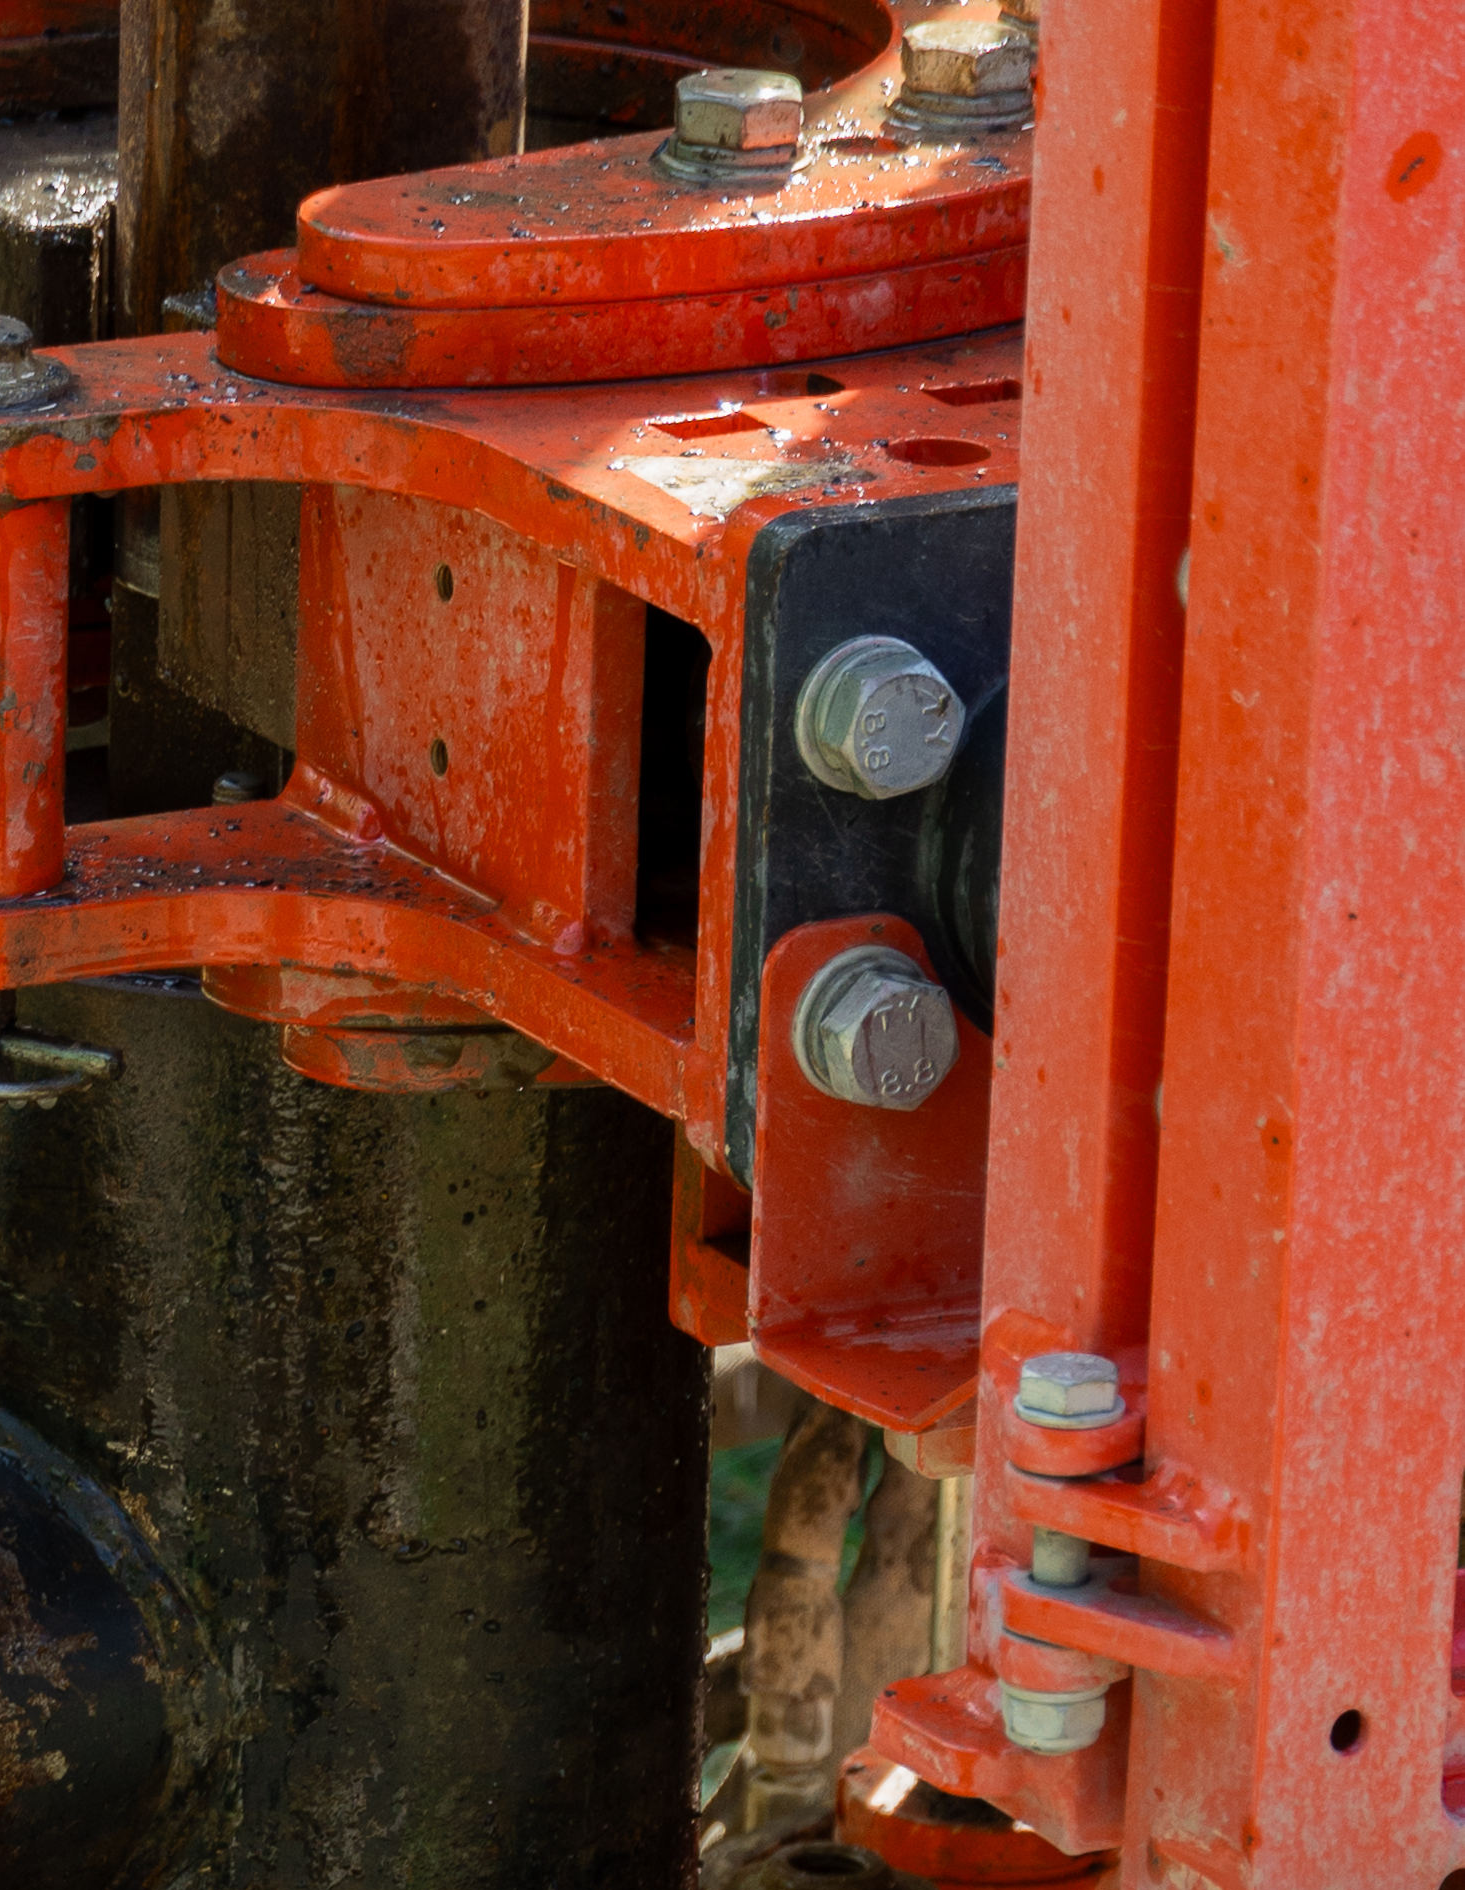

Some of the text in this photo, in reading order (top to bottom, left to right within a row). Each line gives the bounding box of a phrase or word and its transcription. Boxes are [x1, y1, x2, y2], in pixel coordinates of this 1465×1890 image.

[861, 709, 892, 773] 8.8
[872, 994, 919, 1034] TY
[880, 1055, 936, 1096] 8.8
